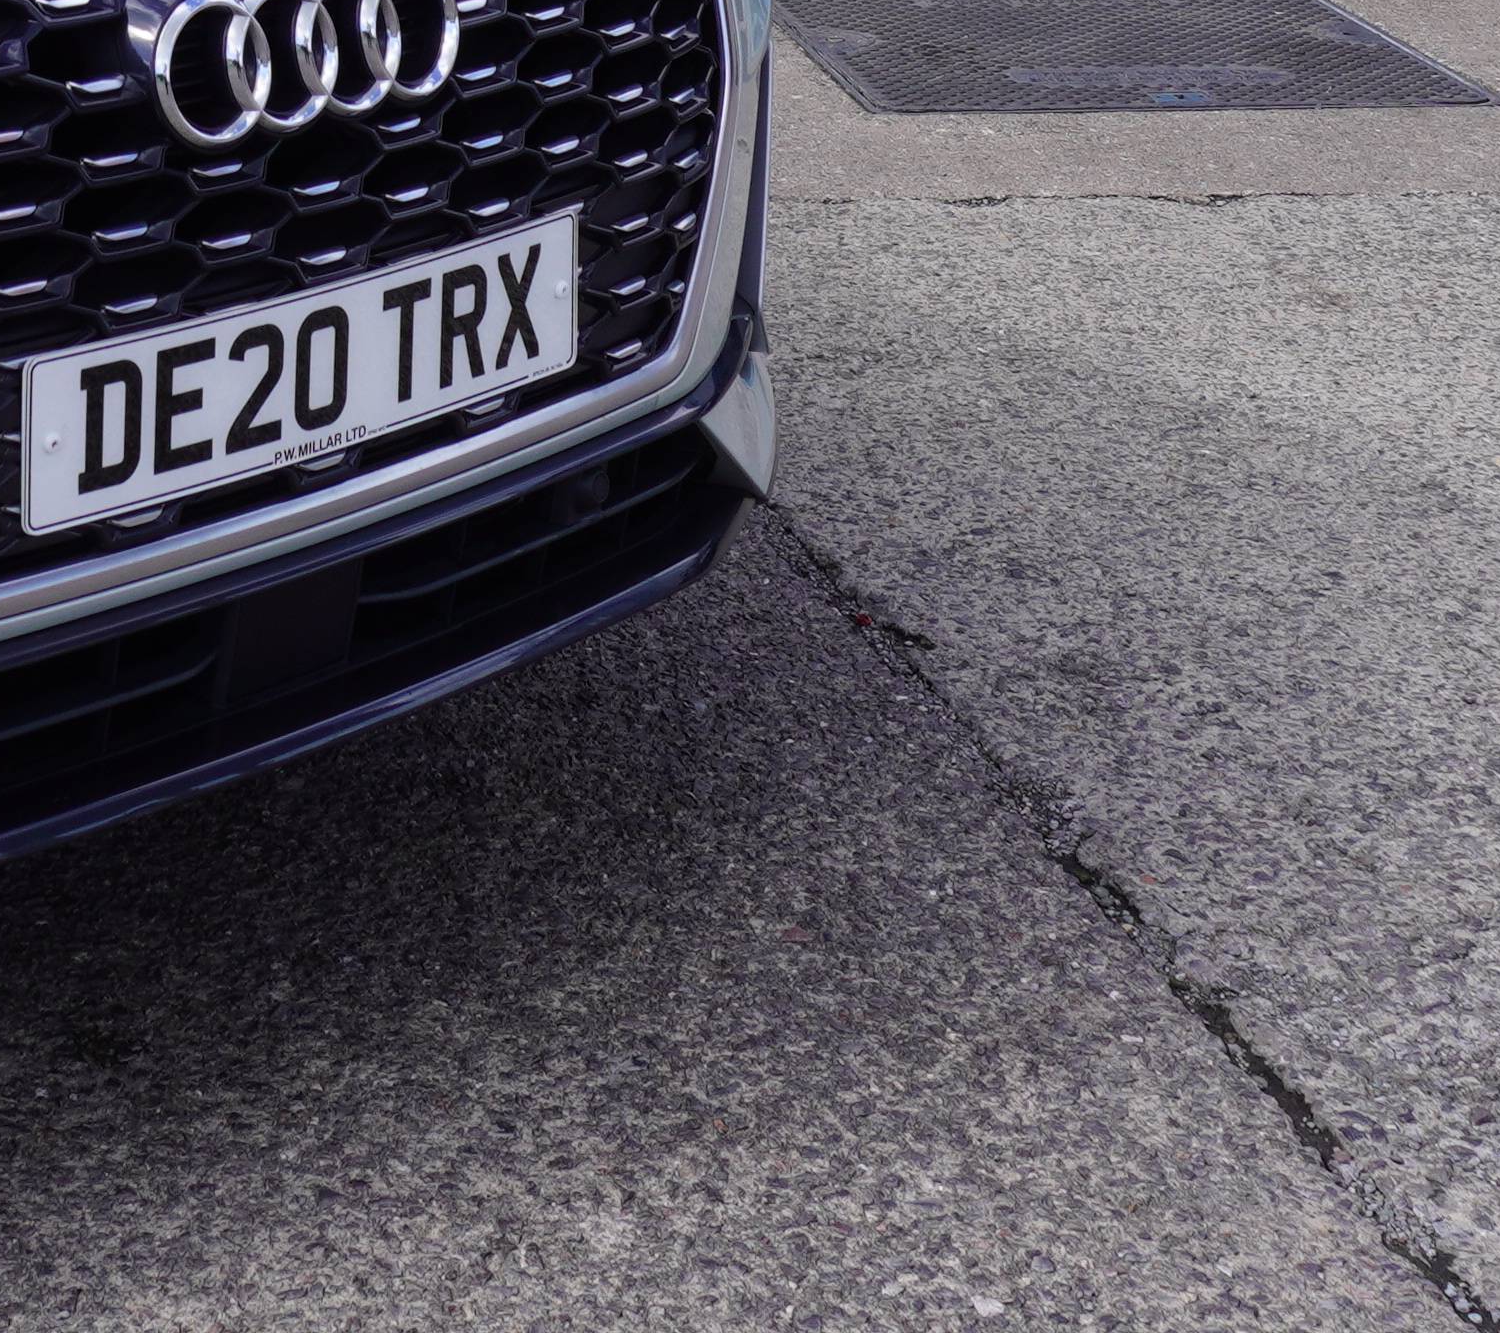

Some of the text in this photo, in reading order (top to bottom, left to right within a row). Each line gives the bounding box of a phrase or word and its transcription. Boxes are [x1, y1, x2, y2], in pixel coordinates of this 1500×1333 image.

[77, 243, 542, 495] DE20 TRX
[345, 424, 367, 443] LTD
